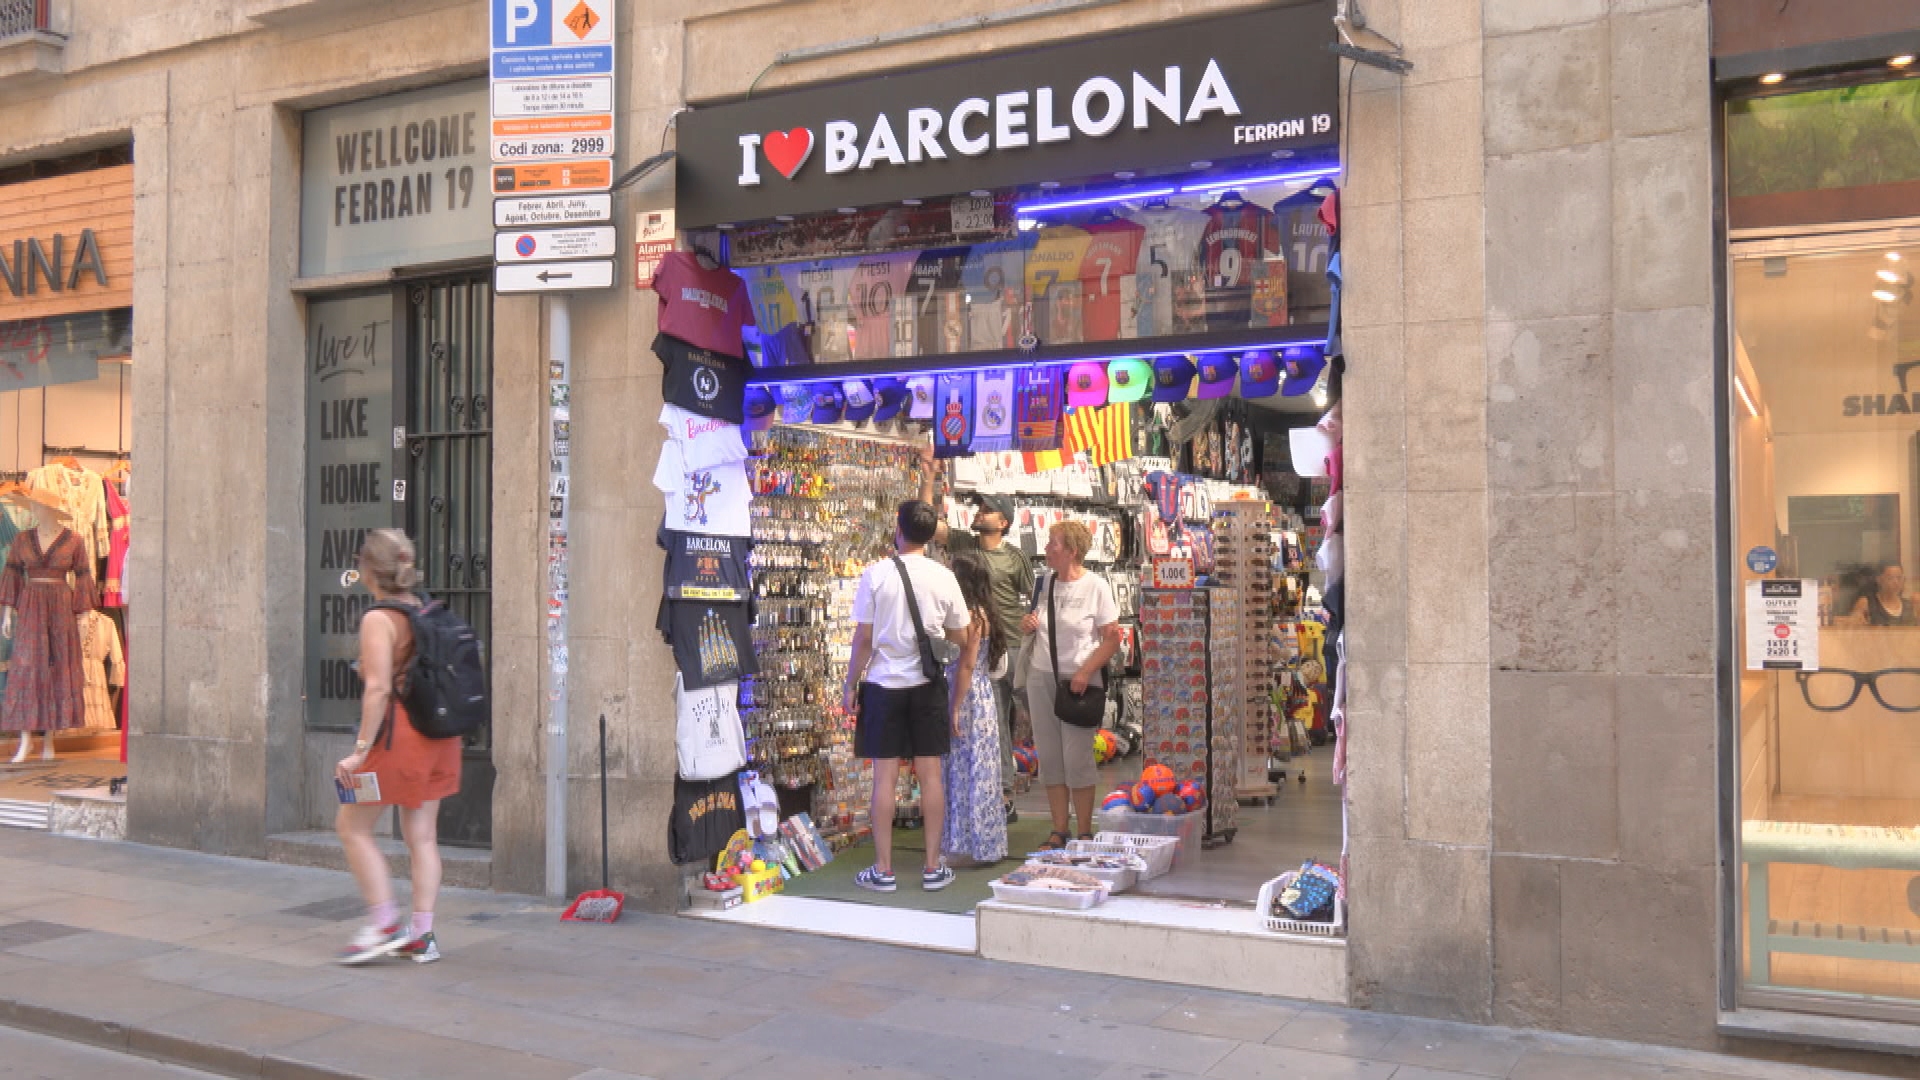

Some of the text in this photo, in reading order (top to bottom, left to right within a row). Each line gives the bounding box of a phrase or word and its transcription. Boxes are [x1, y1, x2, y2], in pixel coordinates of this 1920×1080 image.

[506, 0, 538, 43] P
[738, 57, 1242, 186] I BARCELONA
[1233, 113, 1331, 144] FERRAN 19
[336, 111, 476, 176] WELLCOME
[499, 137, 604, 156] Codi zona: 2999
[335, 165, 474, 227] FERRAN 19
[518, 199, 588, 211] Febrer, Abril, Juny,
[505, 209, 601, 223] Agost, Octubre, Desembre
[1292, 223, 1329, 237] LAUTA
[0, 228, 107, 298] NNA
[638, 243, 672, 253] Alarma
[858, 260, 891, 277] MESSI
[1035, 269, 1060, 298] 7
[1095, 257, 1112, 297] 7
[1220, 248, 1242, 288] 9
[856, 281, 893, 317] 10
[917, 277, 936, 317] 7
[314, 319, 391, 375] Live it
[320, 397, 369, 441] LIKE
[320, 462, 381, 505] HOME
[320, 527, 373, 570] AWA
[686, 536, 731, 553] BARCELONA
[1160, 567, 1186, 581] 1.00€
[1765, 599, 1798, 607] OUTLET
